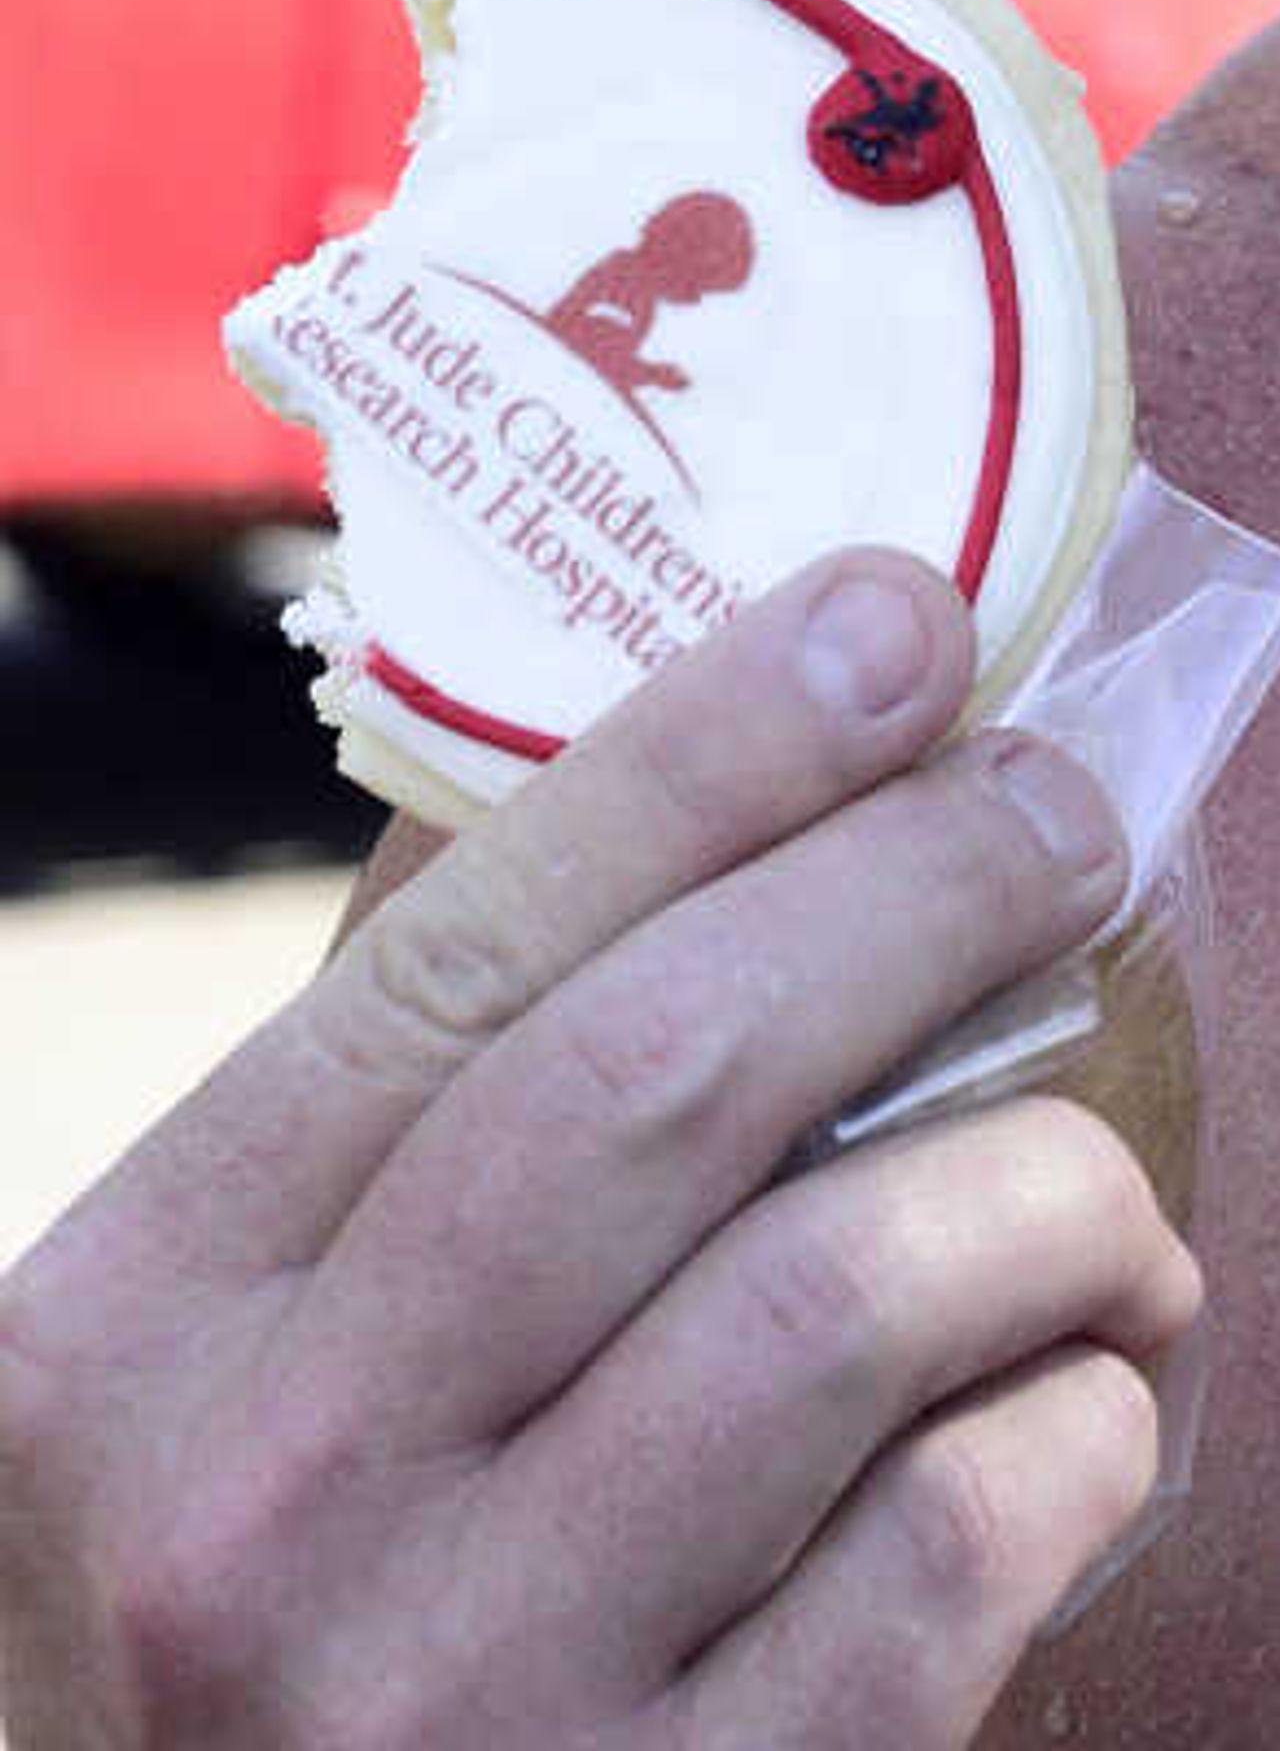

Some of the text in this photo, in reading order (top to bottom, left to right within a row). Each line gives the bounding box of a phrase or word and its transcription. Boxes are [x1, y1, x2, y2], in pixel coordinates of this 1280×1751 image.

[364, 283, 495, 410] Jude
[273, 314, 686, 668] esearch Hospita
